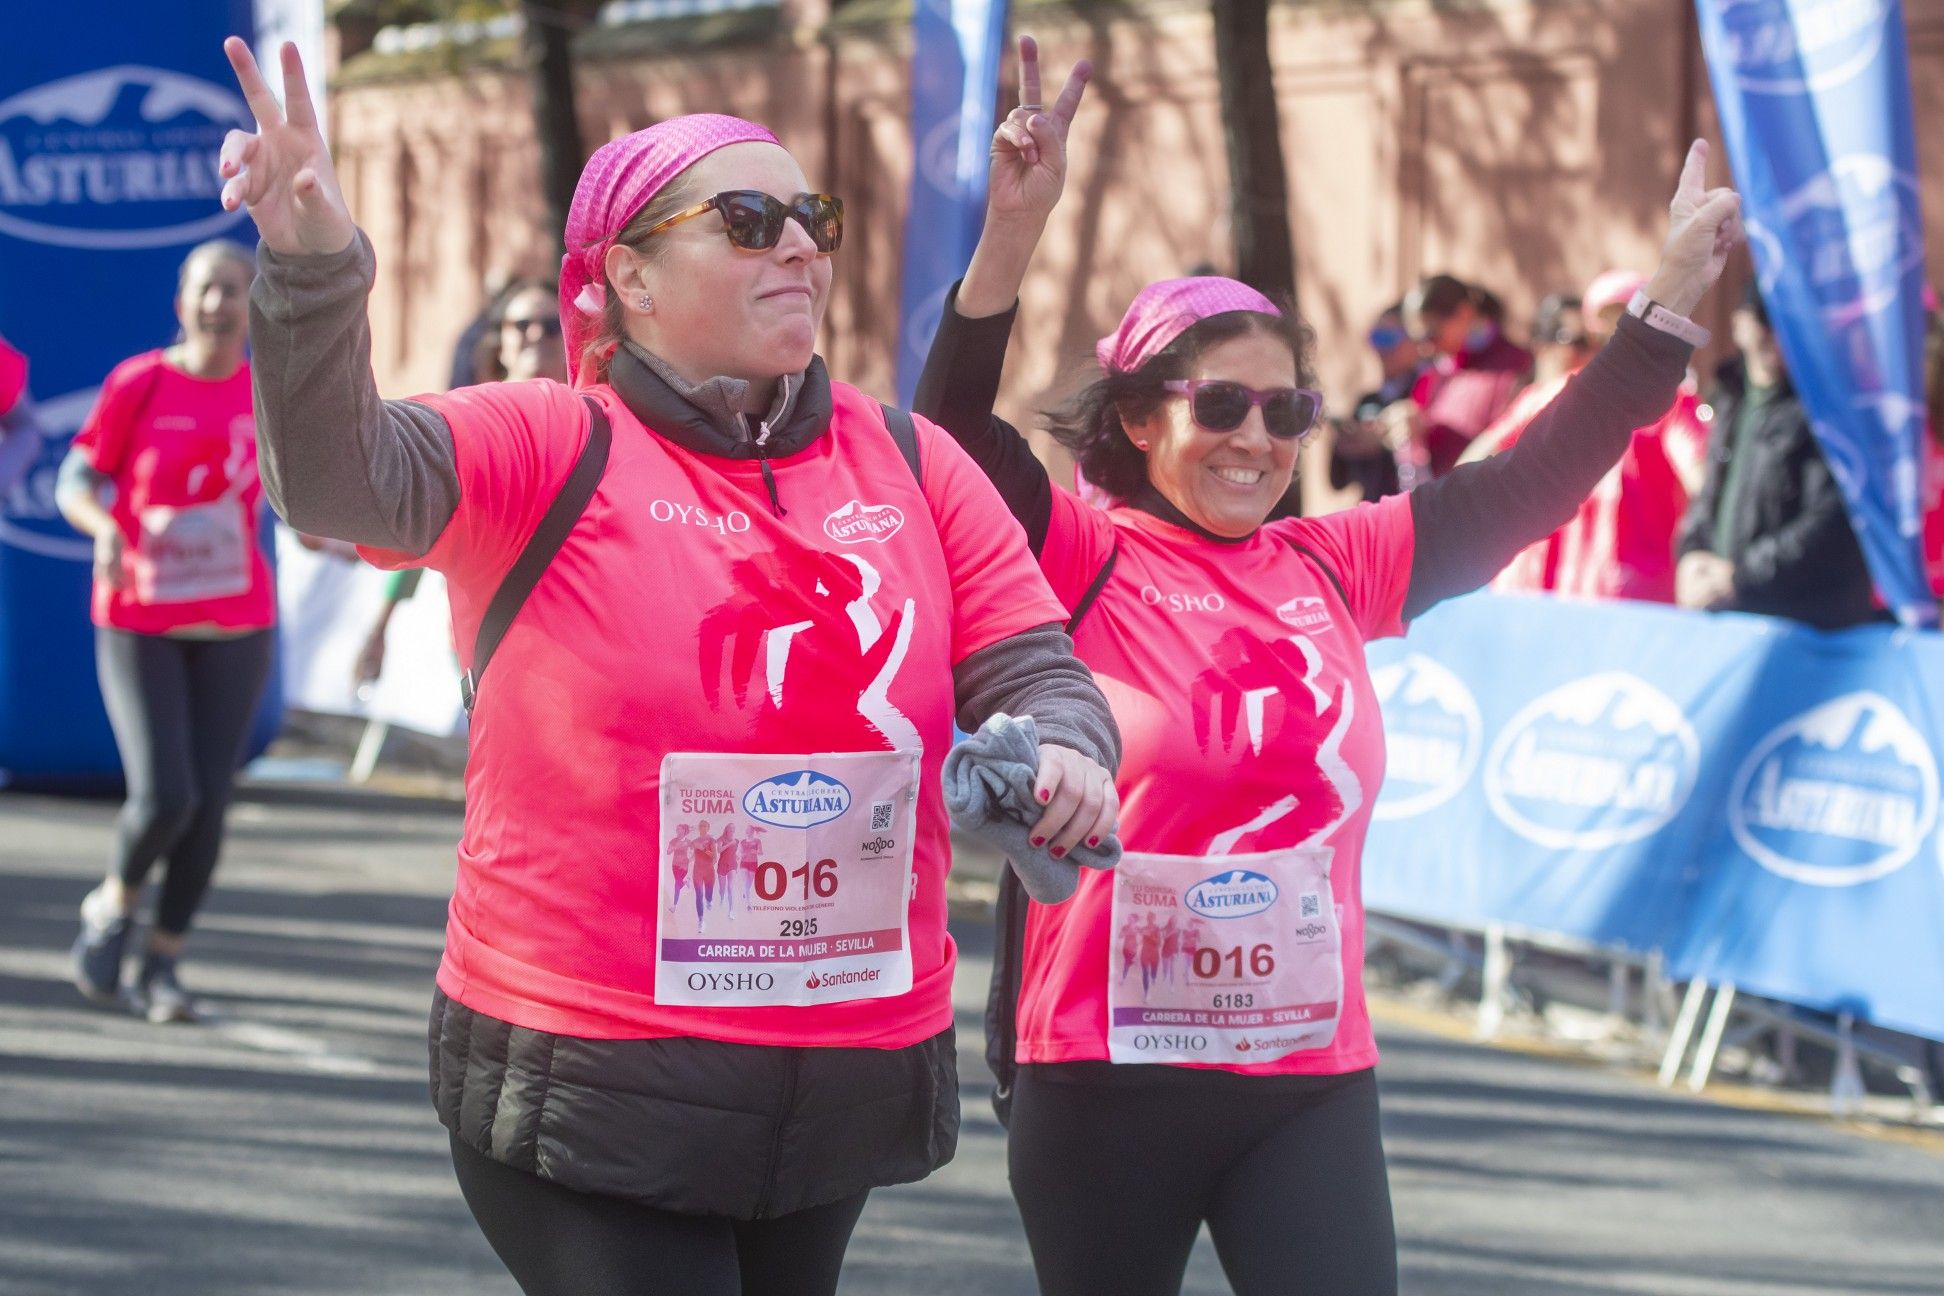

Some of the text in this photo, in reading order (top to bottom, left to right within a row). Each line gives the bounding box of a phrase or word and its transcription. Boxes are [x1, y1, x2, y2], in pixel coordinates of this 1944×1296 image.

[0, 134, 222, 205] ASTURIA
[1140, 585, 1225, 613] OSHO
[680, 789, 735, 798] TU DORSAL
[751, 790, 843, 814] ASTURIANA
[682, 799, 735, 814] SUMA
[754, 858, 838, 901] 016
[1133, 892, 1178, 908] SUMA
[1192, 889, 1272, 908] ASTURIANA
[779, 917, 818, 937] 2925
[697, 936, 875, 958] CARRERA DE LA MUJER SEVILLA
[1192, 943, 1275, 979] 016
[687, 972, 774, 991] OYSHO
[821, 967, 881, 988] Santander
[1212, 993, 1254, 1009] 6183
[1141, 1008, 1312, 1025] CARRERA DE LA MUJER SEVILLA
[1133, 1034, 1207, 1051] OYSHO
[1253, 1032, 1315, 1051] Santan
